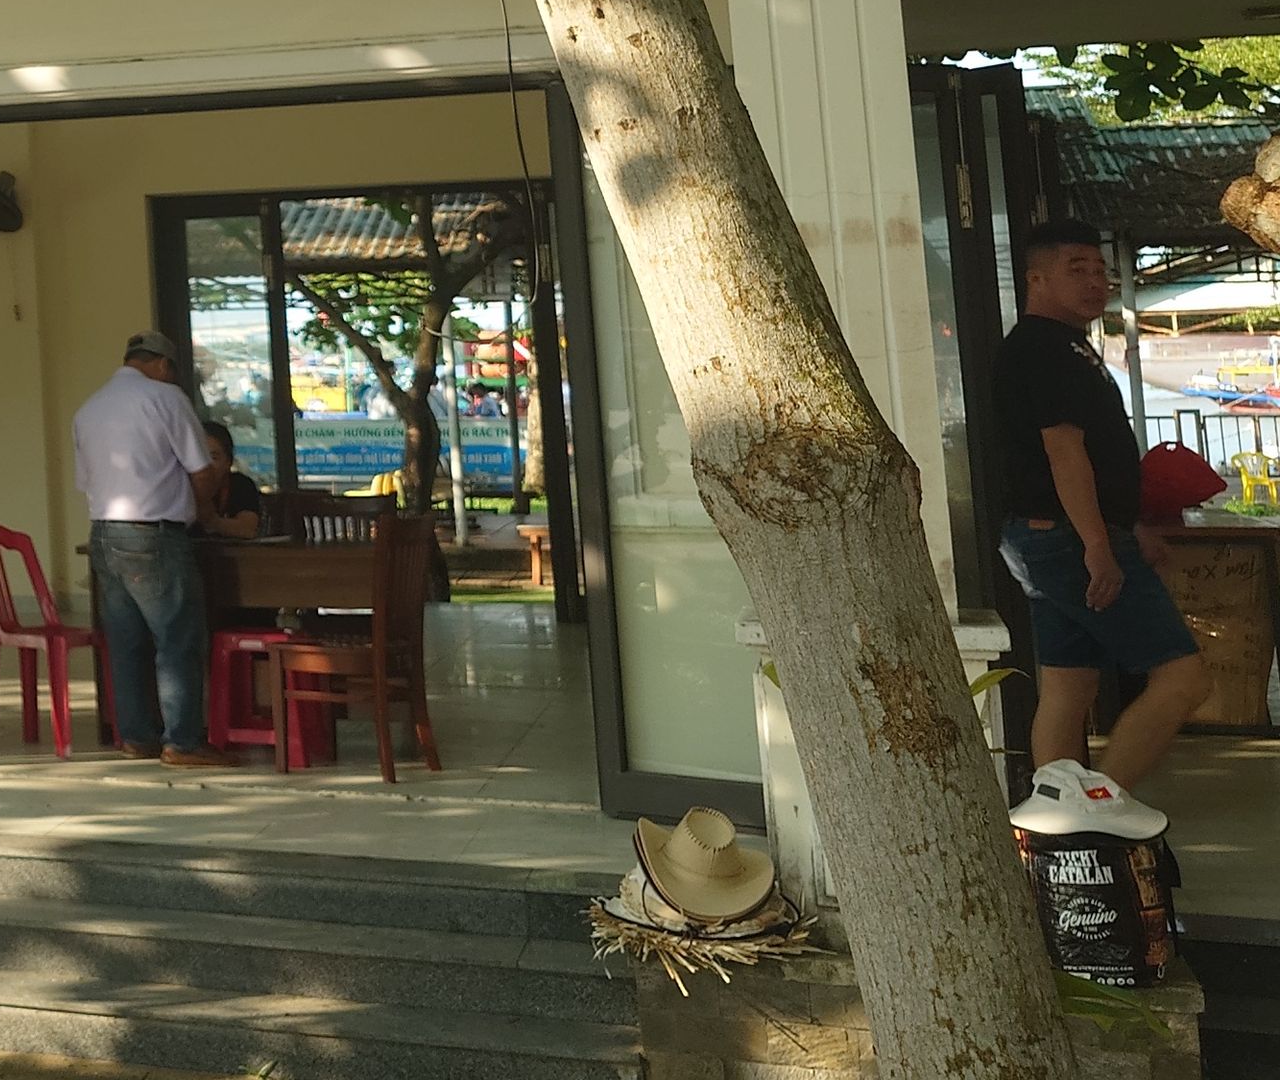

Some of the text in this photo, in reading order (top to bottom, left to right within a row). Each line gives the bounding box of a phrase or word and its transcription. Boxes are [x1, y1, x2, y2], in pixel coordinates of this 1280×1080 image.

[1053, 849, 1099, 867] VICHY
[1049, 865, 1114, 885] CATALAN
[1059, 908, 1119, 932] Genuino
